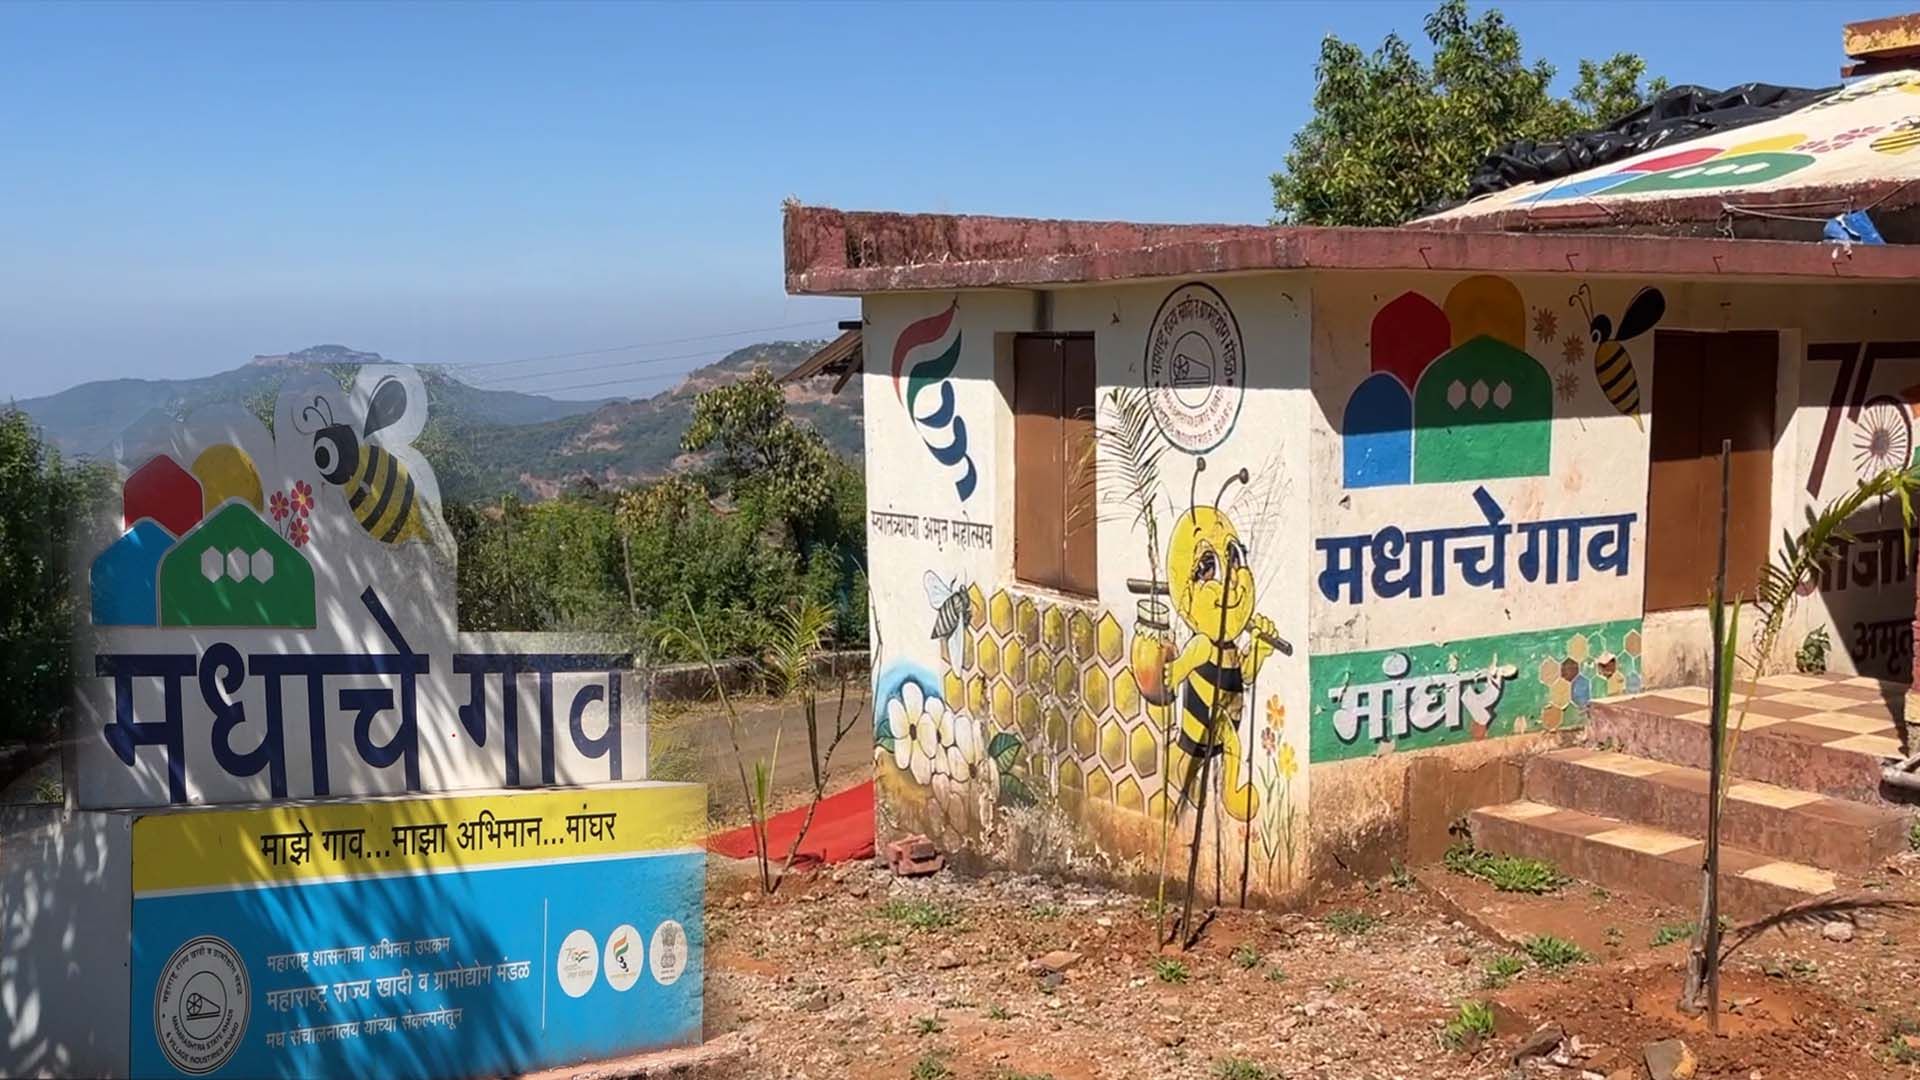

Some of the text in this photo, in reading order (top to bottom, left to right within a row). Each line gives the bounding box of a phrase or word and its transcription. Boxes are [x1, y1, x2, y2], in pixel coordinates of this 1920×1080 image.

[952, 510, 993, 551] महोत्सव
[1315, 486, 1637, 605] मधाचे गाव
[95, 586, 634, 804] मधाचे गाव
[1328, 651, 1518, 743] मांघर
[261, 820, 312, 865] माझे
[312, 945, 365, 968] शासनाचा
[369, 937, 410, 960] अभिनव
[415, 936, 451, 955] उपक्रम
[266, 956, 531, 1013] महाराष्ट्र राज्य खादी व ग्रामोद्योग मंडळ
